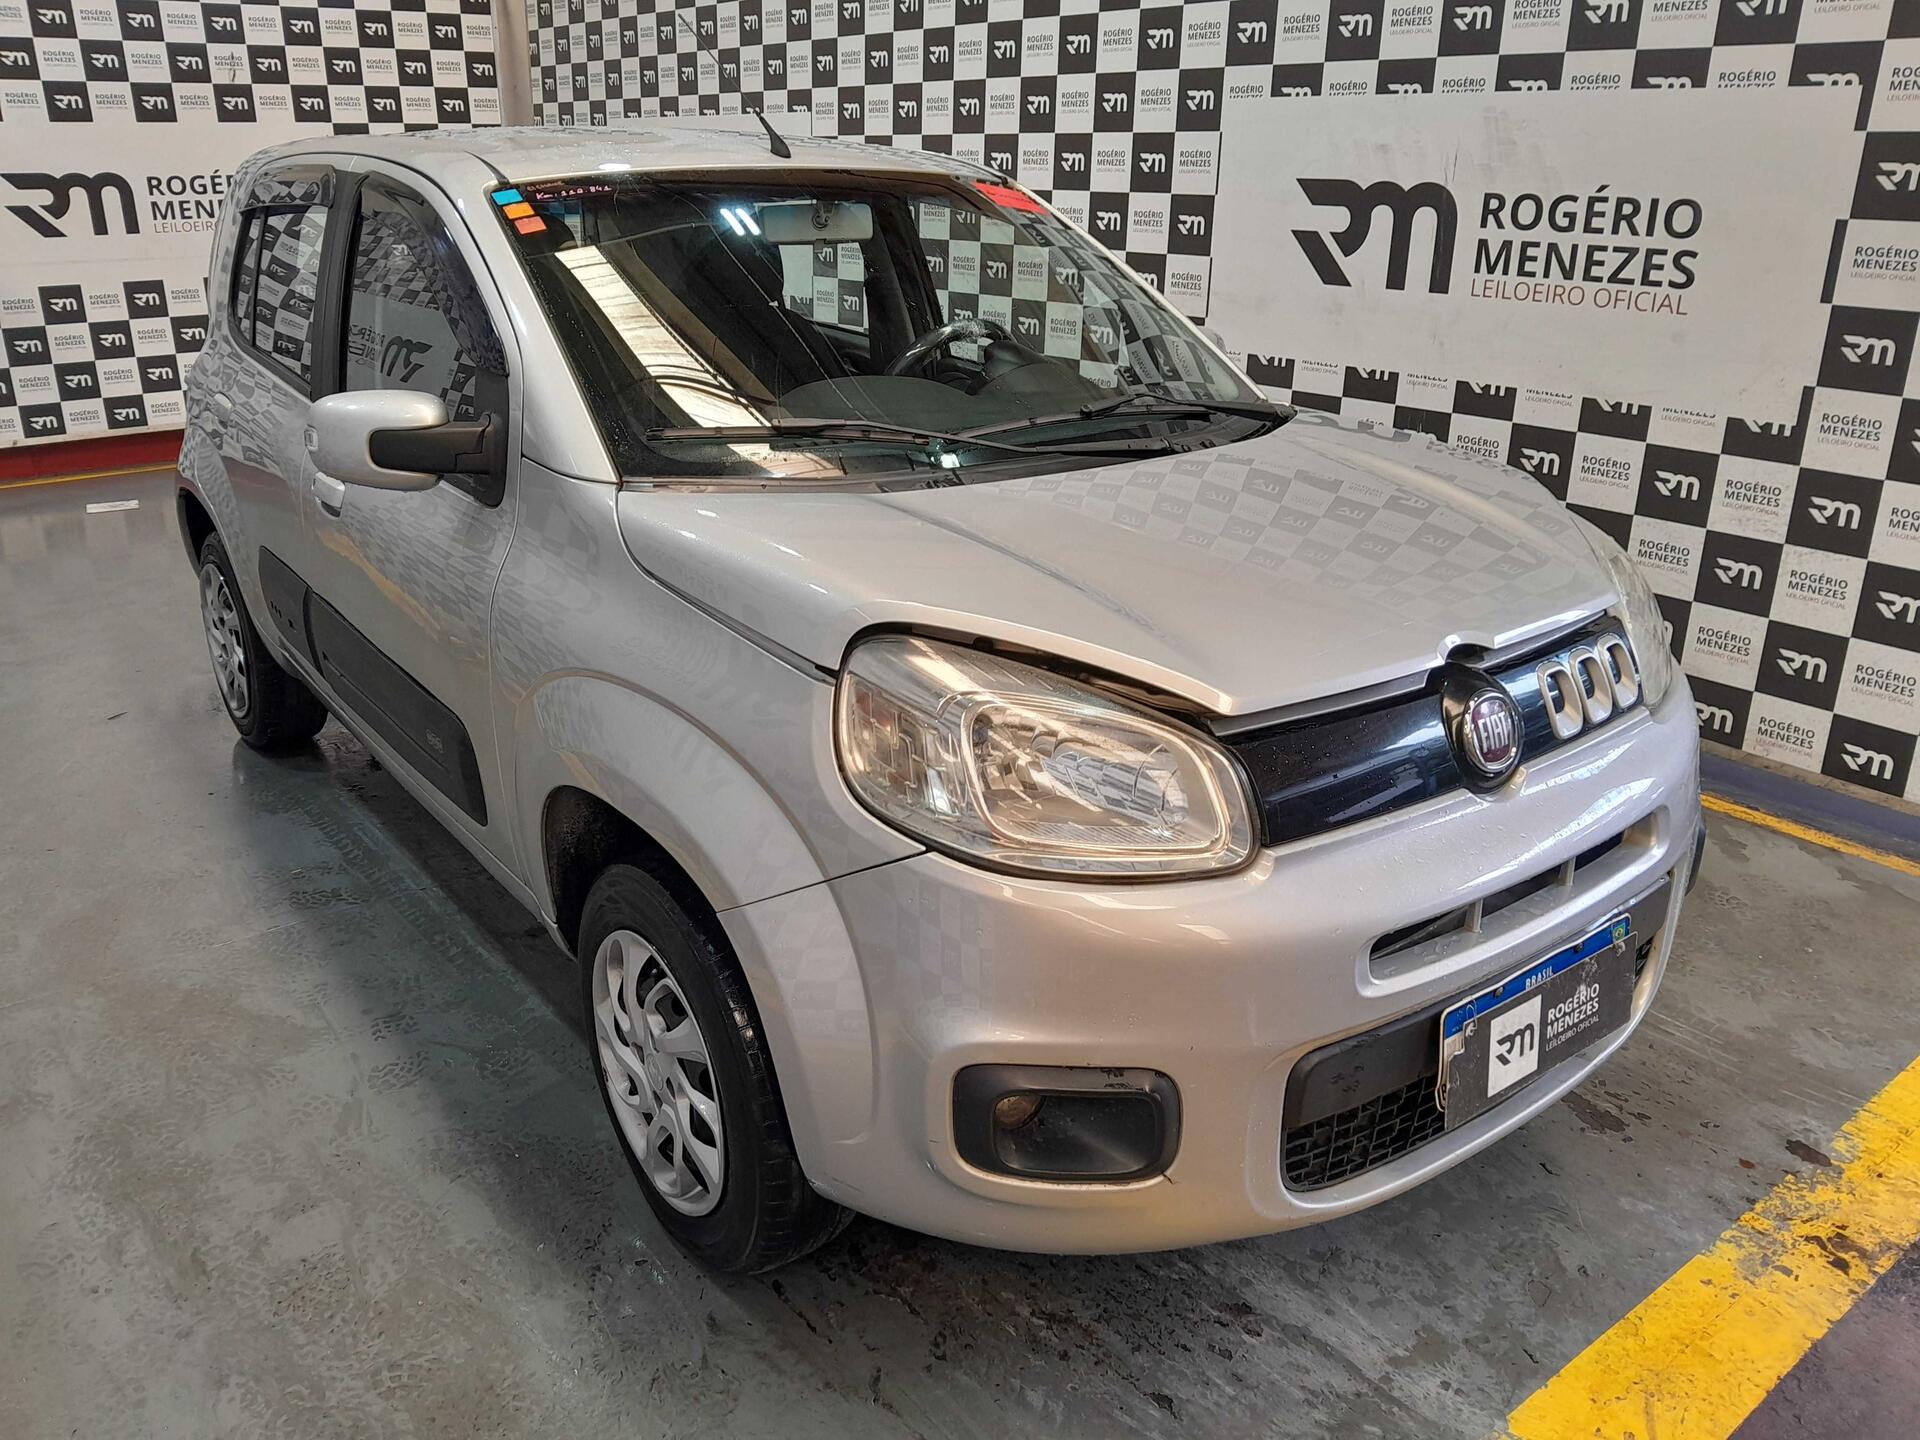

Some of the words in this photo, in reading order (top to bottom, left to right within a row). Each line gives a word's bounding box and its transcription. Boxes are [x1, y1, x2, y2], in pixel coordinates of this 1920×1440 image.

[1392, 5, 1433, 17] ROGÉRIO
[1653, 0, 1708, 12] MENEZES
[1284, 13, 1320, 24] ROGÉRIO
[1513, 8, 1560, 20] MENEZES
[1189, 21, 1221, 31] ROGÉRIO
[1391, 16, 1432, 27] MENEZES
[1103, 28, 1132, 38] ROGÉRIO
[1283, 23, 1320, 34] MENEZES
[1027, 34, 1053, 43] ROGÉRIO
[1103, 37, 1132, 46] MENEZES
[1188, 31, 1220, 40] MENEZES
[897, 46, 918, 54] ROGÉRIO
[958, 40, 982, 49] ROGÉRIO
[1027, 42, 1053, 51] MENEZES
[958, 48, 982, 56] MENEZES
[1571, 72, 1620, 85] ROGÉRIO
[1719, 69, 1776, 82] ROGÉRIO
[1329, 80, 1367, 91] ROGÉRIO
[1442, 76, 1486, 88] ROGÉRIO
[1062, 90, 1089, 99] ROGÉRIO
[1141, 87, 1171, 97] ROGÉRIO
[1230, 84, 1263, 95] ROGÉRIO
[990, 94, 1014, 103] ROGÉRIO
[1061, 99, 1089, 107] MENEZES
[1141, 97, 1171, 105] MENEZES
[990, 102, 1014, 110] MENEZES
[1023, 149, 1048, 157] ROGÉRIO
[1097, 149, 1125, 158] ROGÉRIO
[1180, 149, 1211, 158] ROGÉRIO
[1179, 159, 1211, 167] MENEZES
[1134, 210, 1163, 219] ROGÉRIO
[1480, 184, 1702, 238] ROGÉRIO
[1133, 219, 1163, 227] MENEZES
[1855, 245, 1920, 260] ROGÉRIO
[1018, 260, 1043, 270] ROGÉRIO
[1474, 238, 1700, 290] MENEZES
[1853, 258, 1920, 272] MENEZES
[1018, 268, 1043, 277] MENEZES
[1171, 272, 1202, 282] ROGÉRIO
[1171, 281, 1201, 290] MENEZES
[1470, 278, 1584, 306] LEILOEIRO
[1593, 288, 1688, 315] OFICIAL
[1050, 318, 1076, 327] ROGÉRIO
[1050, 326, 1076, 335] MENEZES
[1822, 413, 1882, 430] ROGÉRIO
[1820, 424, 1880, 441] MENEZES
[1457, 435, 1499, 449] ROGÉRIO
[1582, 455, 1630, 471] ROGÉRIO
[1581, 465, 1630, 481] MENEZES
[1726, 479, 1781, 497] ROGÉRIO
[1724, 490, 1780, 507] MENEZES
[1639, 539, 1690, 557] ROGÉRIO
[1638, 549, 1689, 567] MENEZES
[1790, 570, 1848, 589] ROGÉRIO
[1788, 580, 1847, 600] MENEZES
[1698, 626, 1751, 646] ROGÉRIO
[1696, 636, 1750, 656] MENEZES
[1856, 664, 1916, 686] ROGÉRIO
[1854, 674, 1915, 697] MENEZES
[1478, 711, 1508, 754] FIAT
[1760, 717, 1815, 740] ROGÉRIO
[1758, 727, 1814, 750] MENEZES
[1525, 966, 1554, 990] BRASIL
[1548, 983, 1600, 1023] ROGÉRIO
[1546, 999, 1599, 1039] MENEZES
[1545, 1024, 1577, 1052] LEILOEIRO
[1578, 1015, 1600, 1032] OFICIAL
